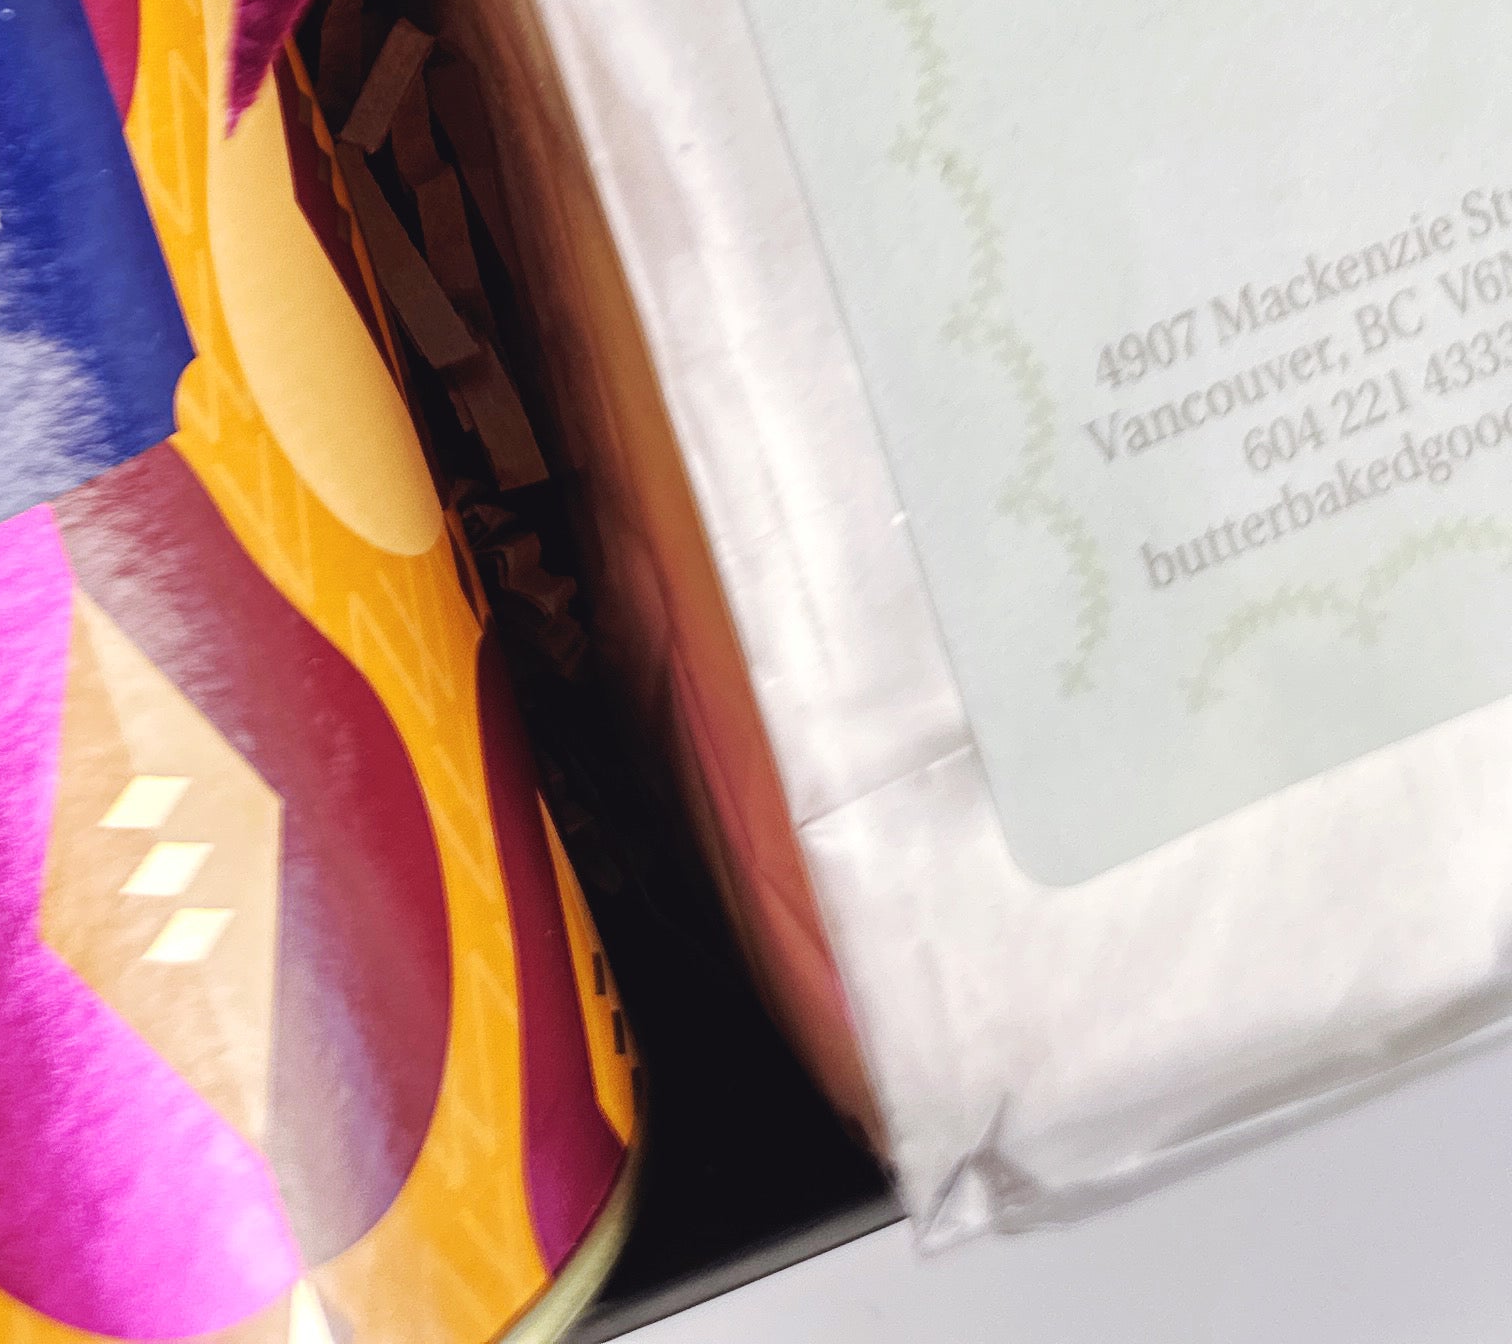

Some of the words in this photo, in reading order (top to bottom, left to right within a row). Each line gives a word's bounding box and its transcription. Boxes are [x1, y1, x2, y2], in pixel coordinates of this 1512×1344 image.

[1081, 334, 1352, 464] Vancouver,
[1353, 285, 1425, 356] BC
[1094, 308, 1198, 389] 4907
[1209, 212, 1455, 347] Mackenzie
[1459, 186, 1512, 243] St
[1139, 401, 1512, 591] butterbakedgoo
[1241, 410, 1326, 474] 604
[1331, 367, 1412, 438] 221
